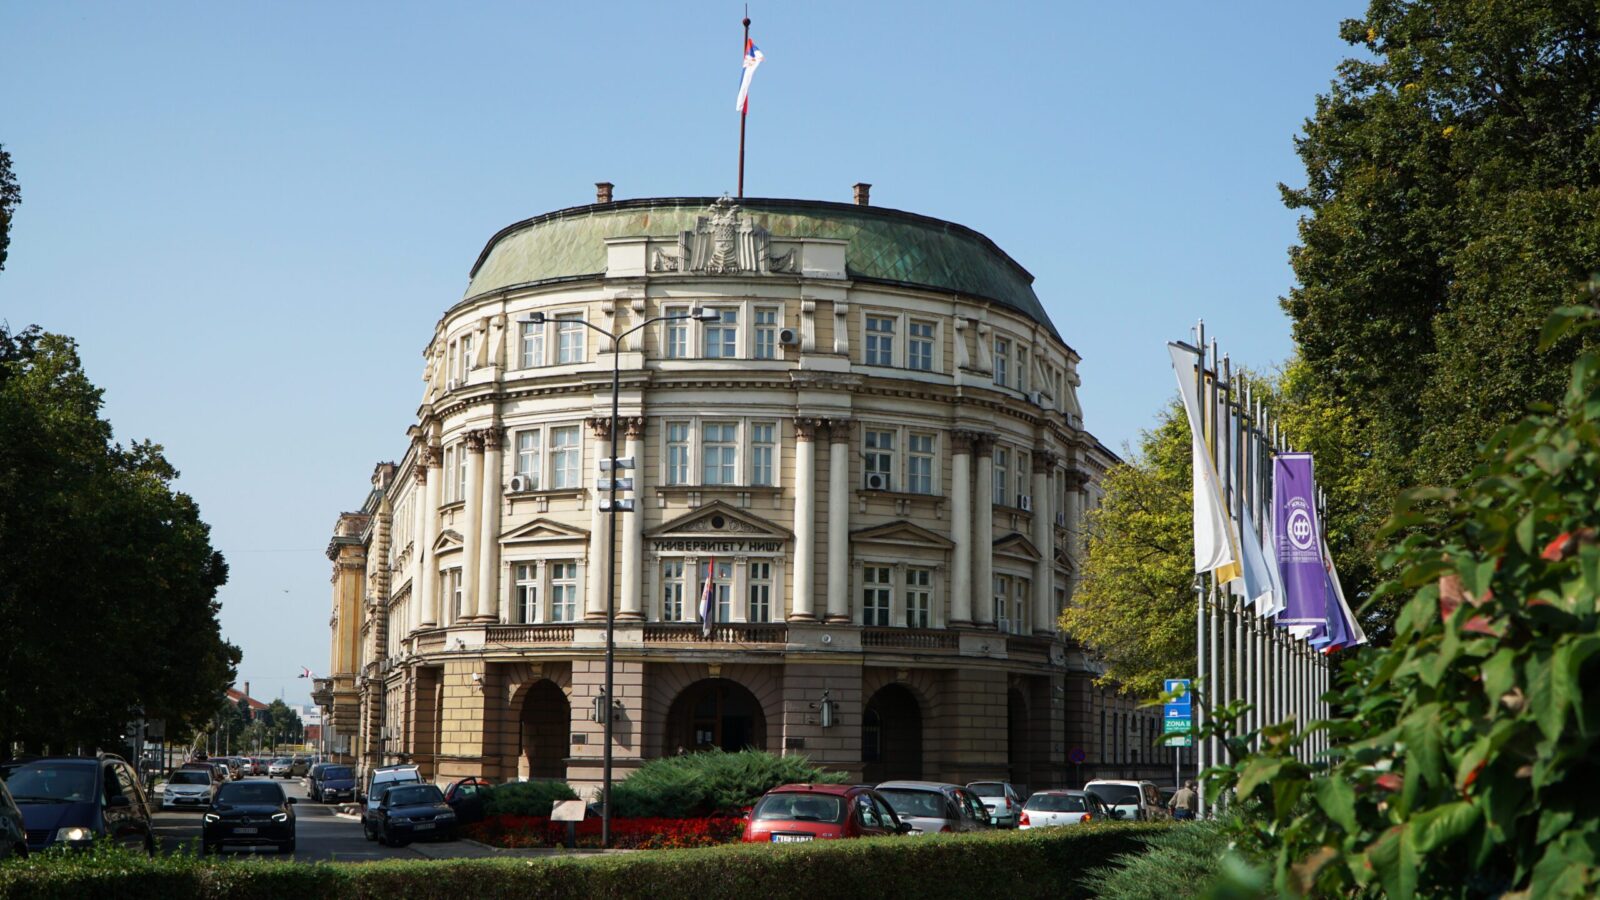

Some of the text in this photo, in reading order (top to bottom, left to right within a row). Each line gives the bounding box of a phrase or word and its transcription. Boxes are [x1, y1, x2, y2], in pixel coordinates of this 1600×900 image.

[654, 541, 783, 552] УНИВЕРЗИТЕТ У НИШУ
